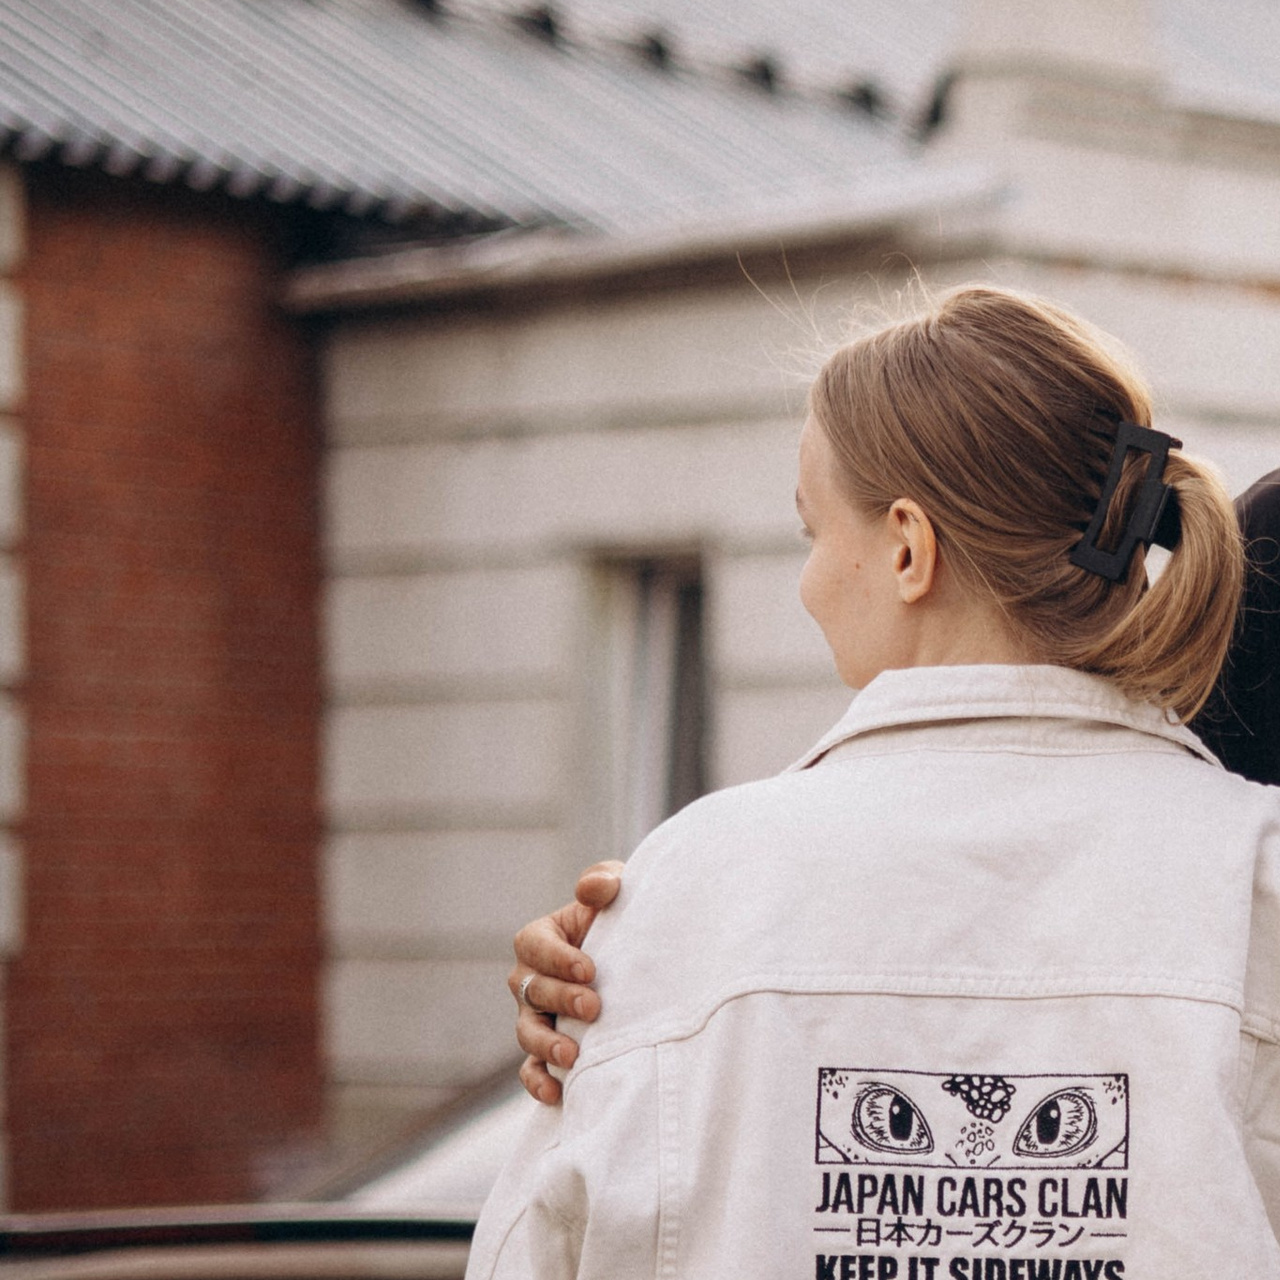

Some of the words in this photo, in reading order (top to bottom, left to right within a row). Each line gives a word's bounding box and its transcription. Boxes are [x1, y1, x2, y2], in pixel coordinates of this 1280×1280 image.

[815, 1172, 925, 1216] JAPAN
[936, 1176, 1027, 1218] CARS
[1037, 1177, 1128, 1219] CLAN
[856, 1216, 1085, 1248] 日本カーズクラン
